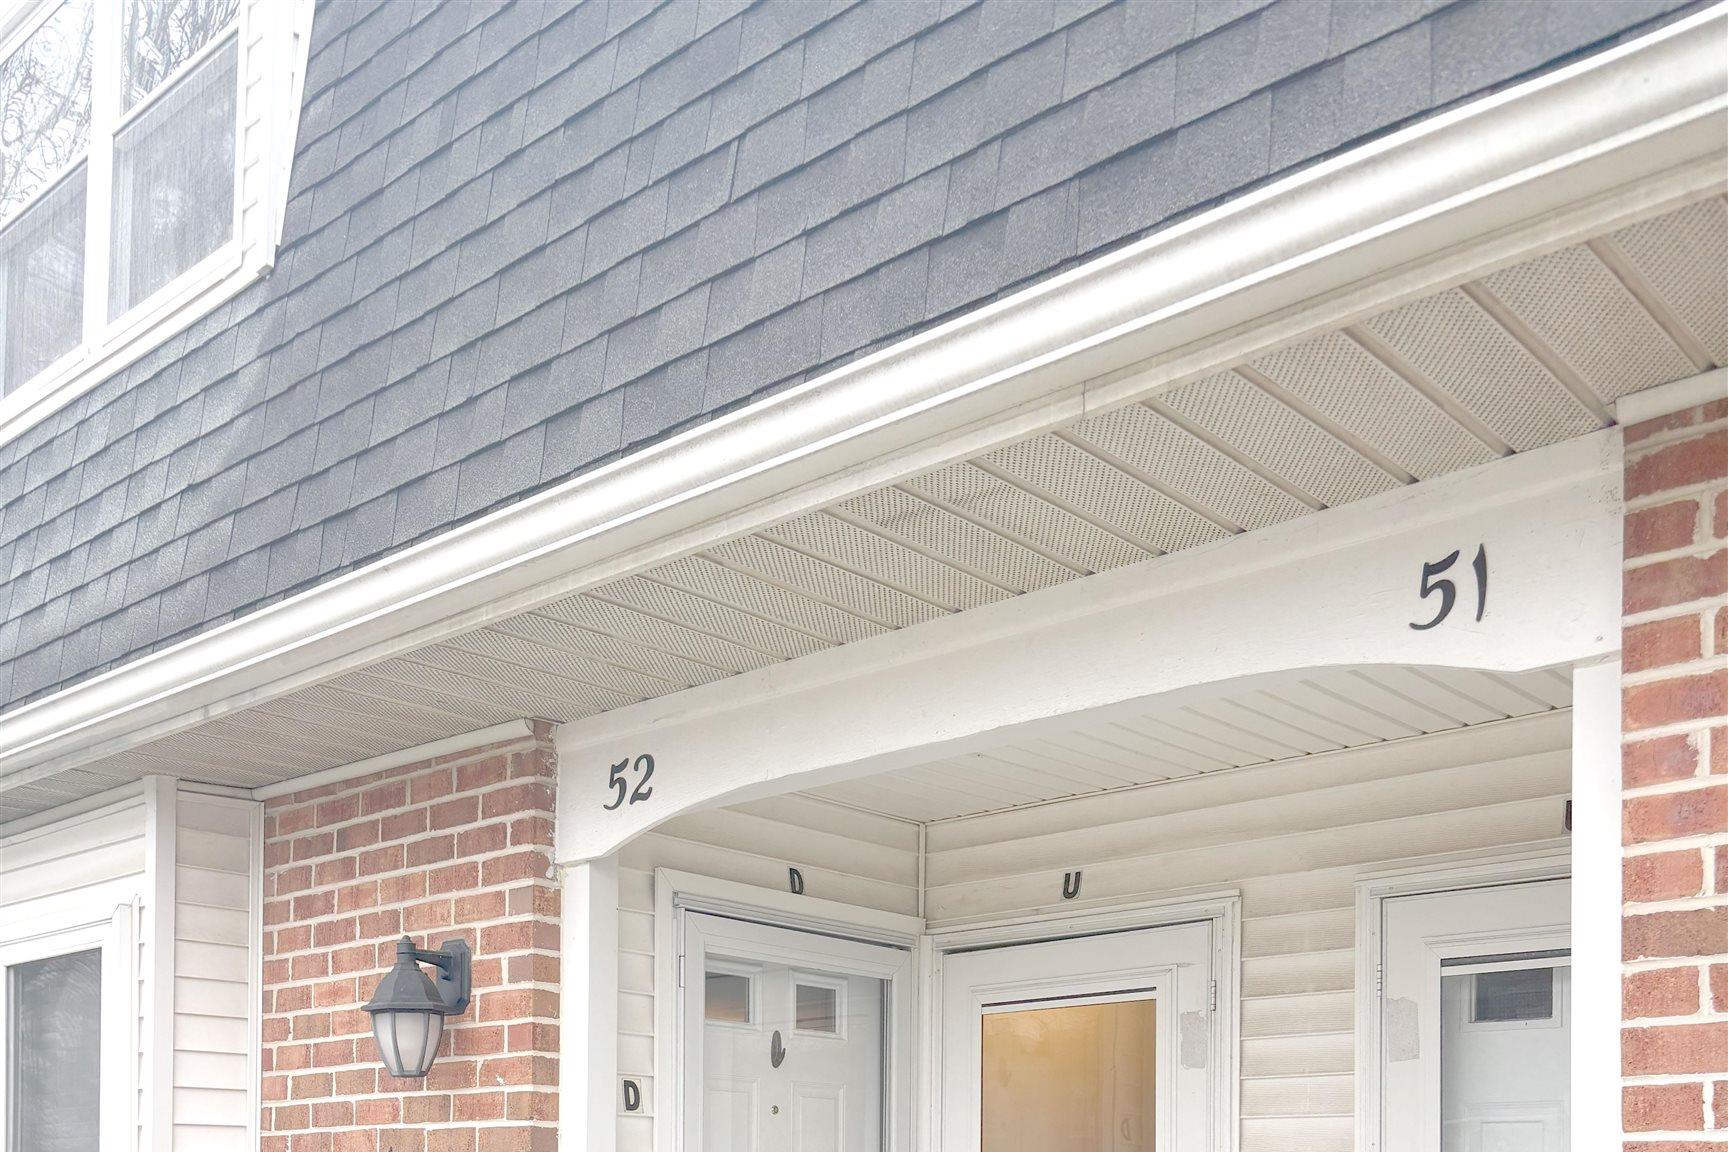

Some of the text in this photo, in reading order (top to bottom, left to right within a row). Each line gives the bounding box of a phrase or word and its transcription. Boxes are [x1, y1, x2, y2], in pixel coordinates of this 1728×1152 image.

[1409, 543, 1487, 630] 51
[603, 753, 655, 810] 52
[789, 867, 804, 895] D
[1063, 871, 1081, 899] U
[623, 1079, 641, 1111] D
